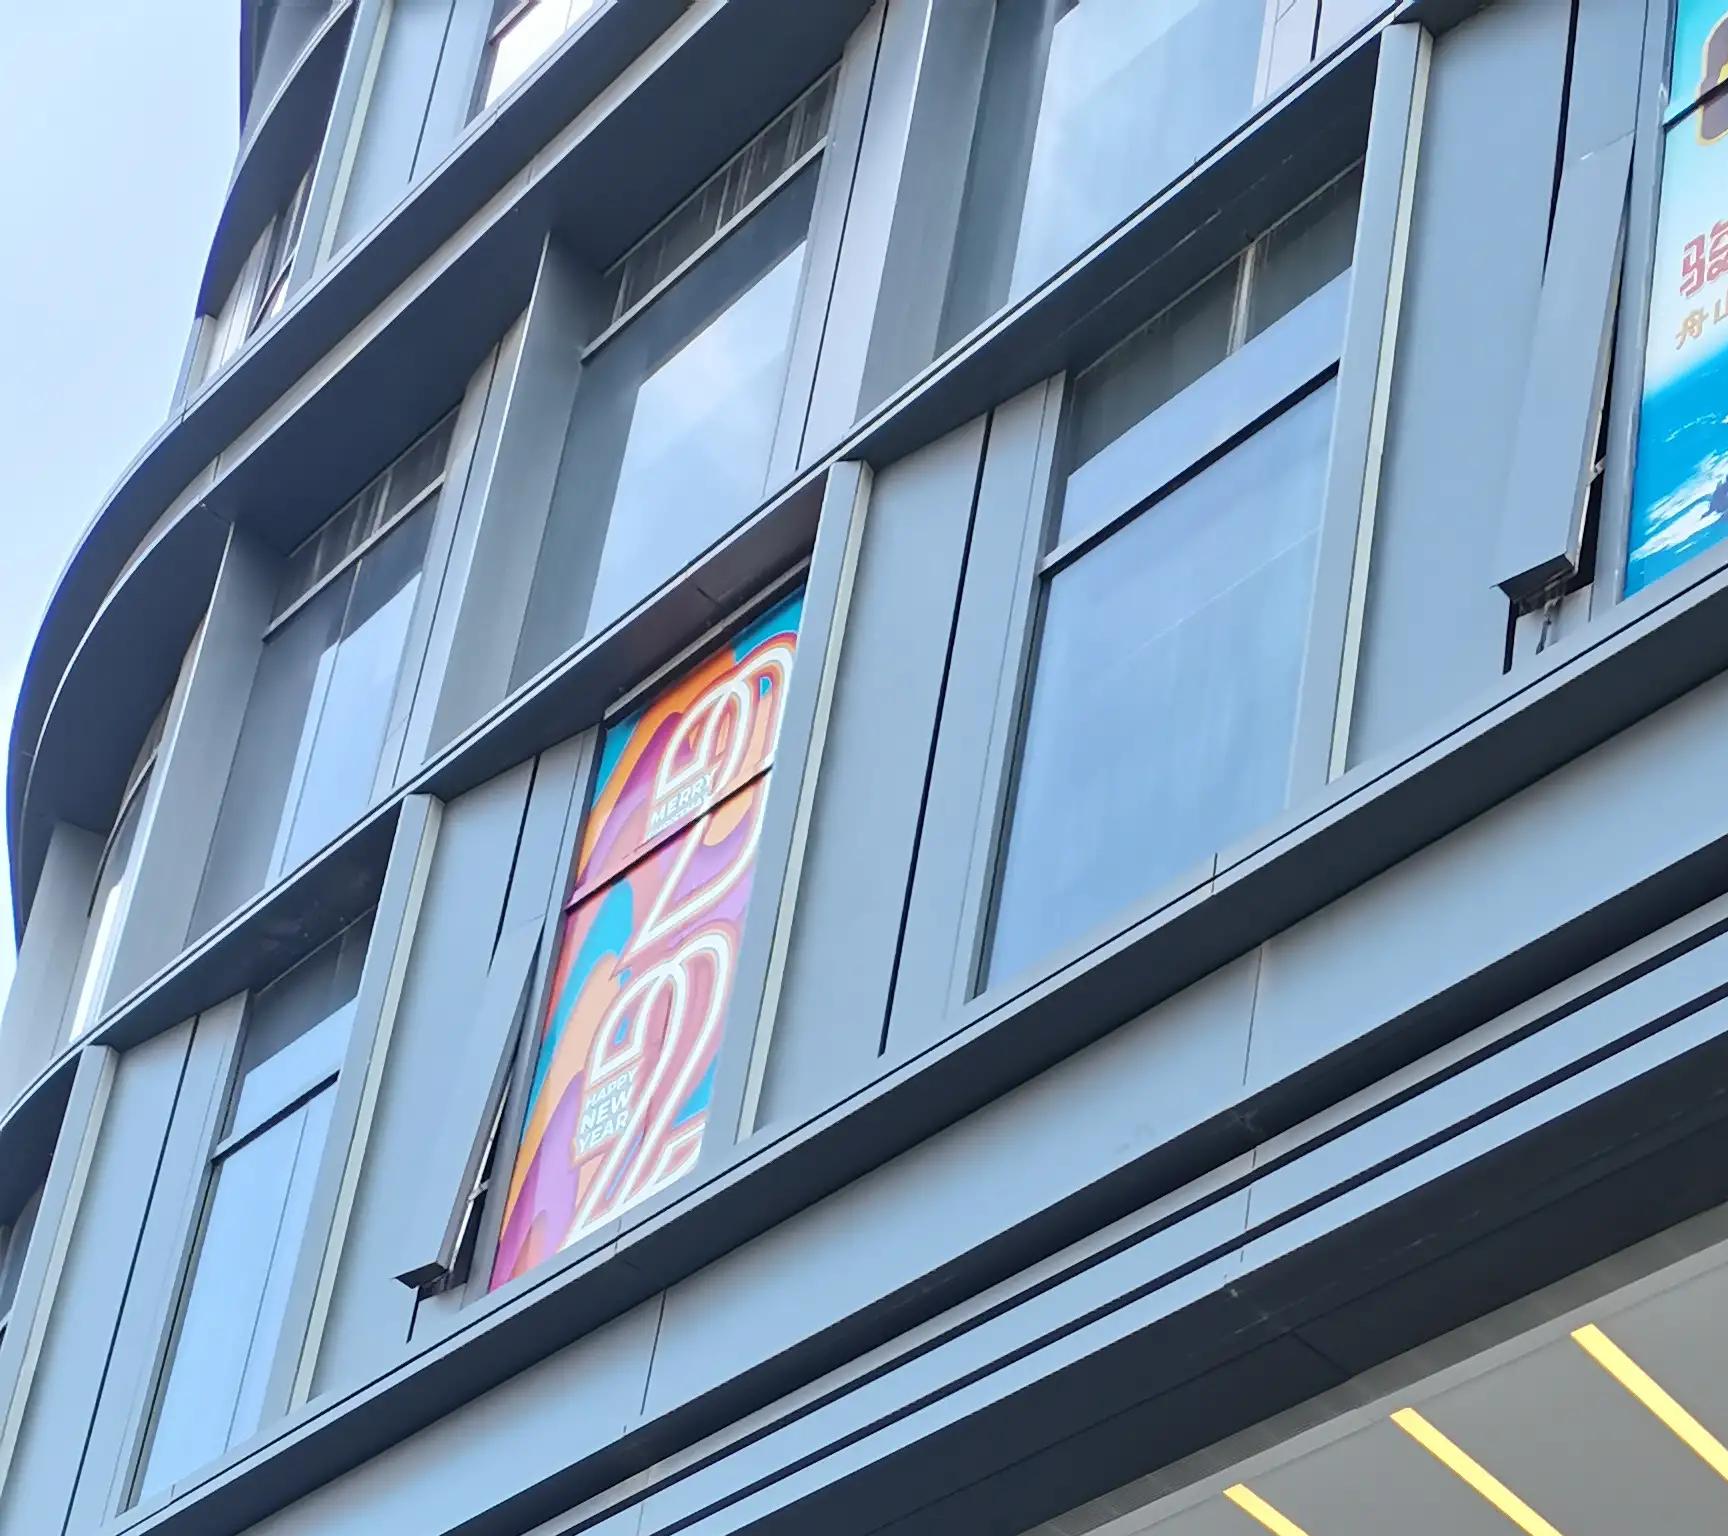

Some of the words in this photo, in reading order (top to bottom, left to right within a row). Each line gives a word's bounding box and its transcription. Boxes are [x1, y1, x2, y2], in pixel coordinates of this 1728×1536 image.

[580, 1087, 633, 1134] NEW
[585, 1066, 638, 1111] HAPPY
[577, 1109, 630, 1153] YEAR
